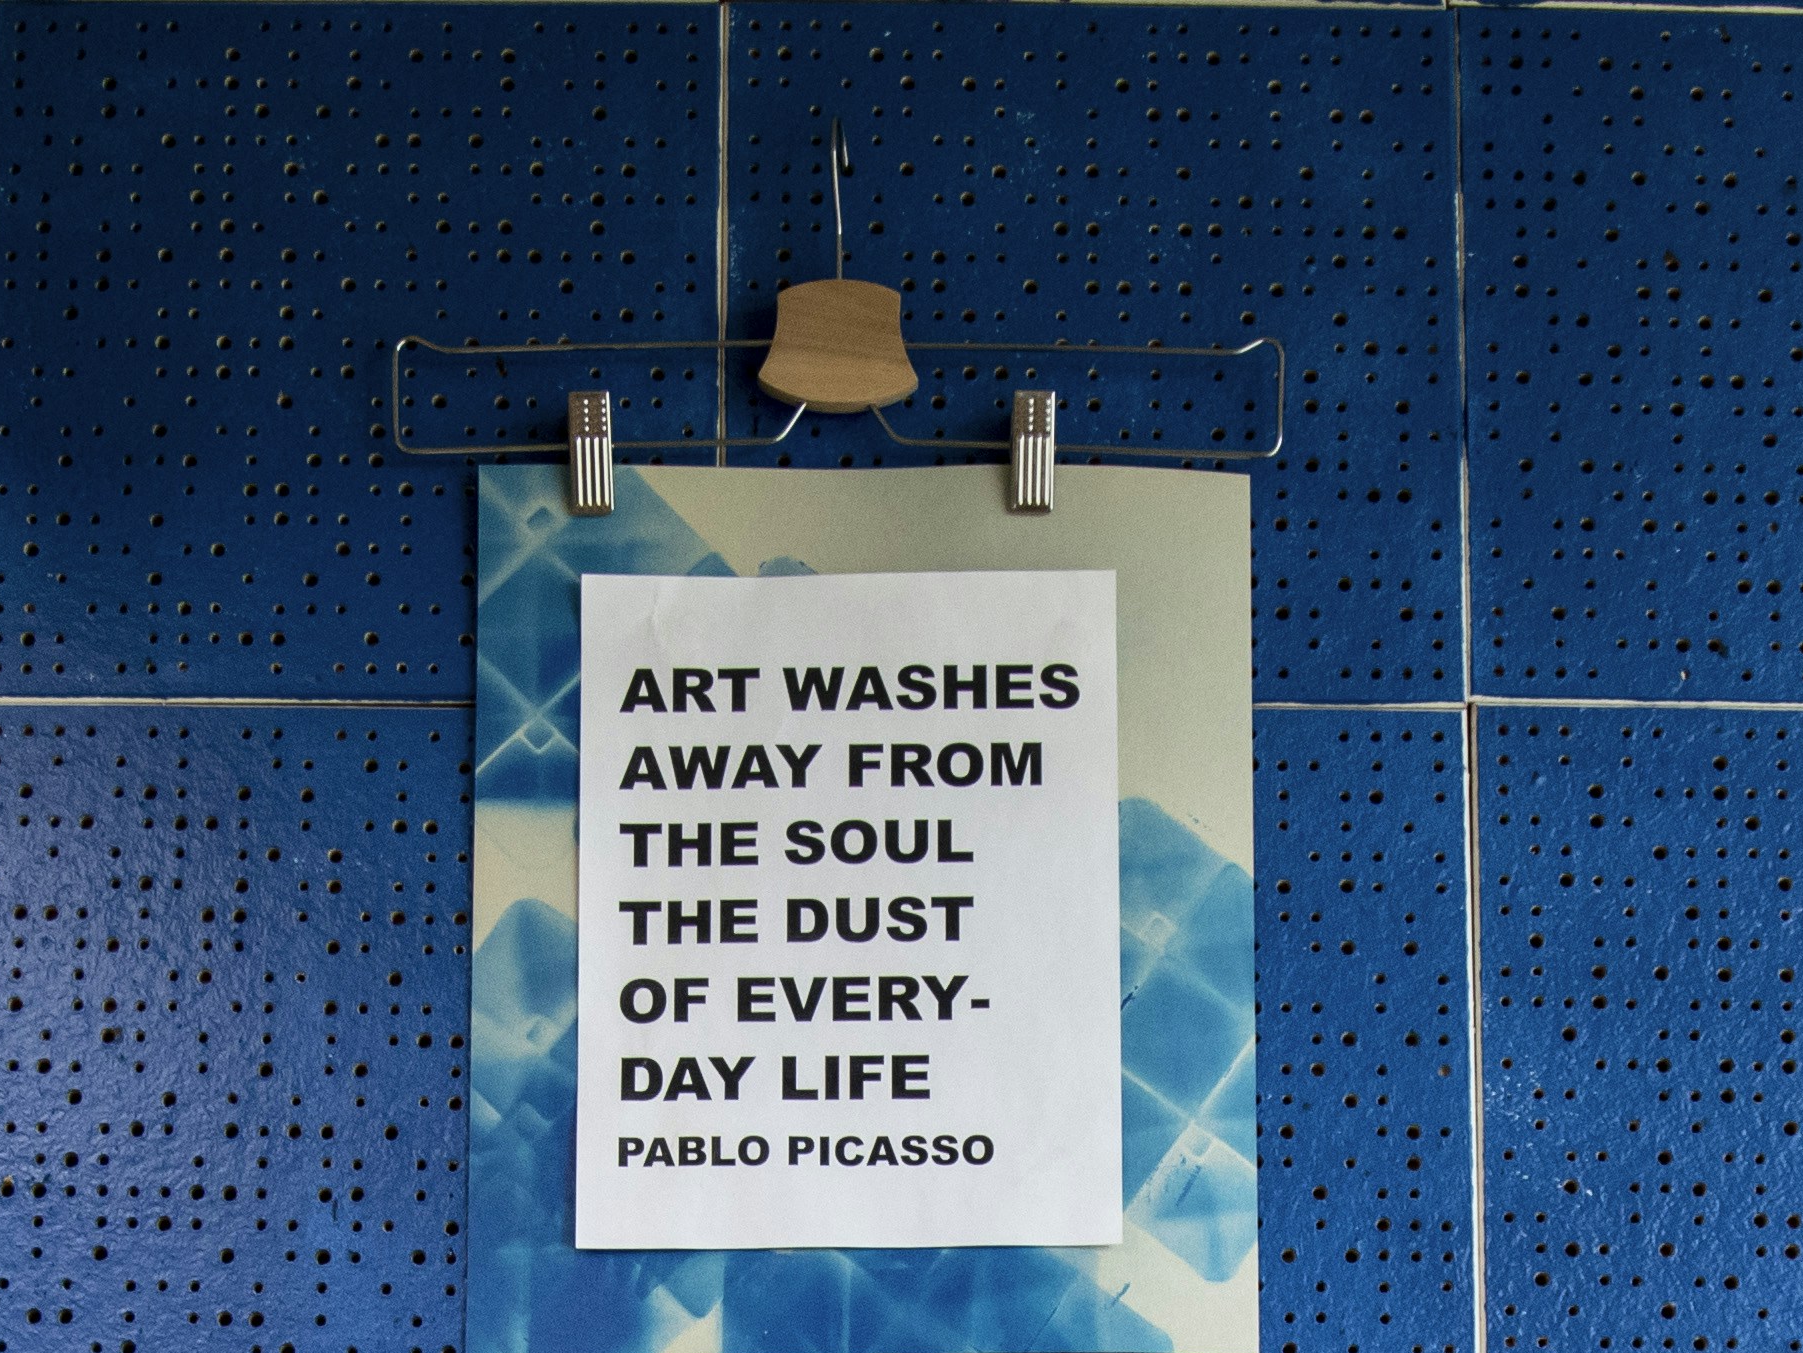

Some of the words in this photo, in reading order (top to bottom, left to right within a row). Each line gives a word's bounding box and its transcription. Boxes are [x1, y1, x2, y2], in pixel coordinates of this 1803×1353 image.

[620, 668, 760, 712] ART
[783, 664, 1080, 711] WASHES
[620, 744, 822, 790] AWAY
[849, 742, 1042, 787] FROM
[620, 822, 758, 867] THE
[785, 820, 973, 865] SOUL
[619, 899, 758, 945] THE
[787, 896, 974, 942] DUST
[620, 978, 709, 1024] OF
[738, 975, 989, 1022] EVERY-
[621, 1057, 755, 1101] DAY
[782, 1055, 930, 1100] LIFE
[619, 1136, 769, 1167] PABLO
[789, 1135, 994, 1166] PICASSO
